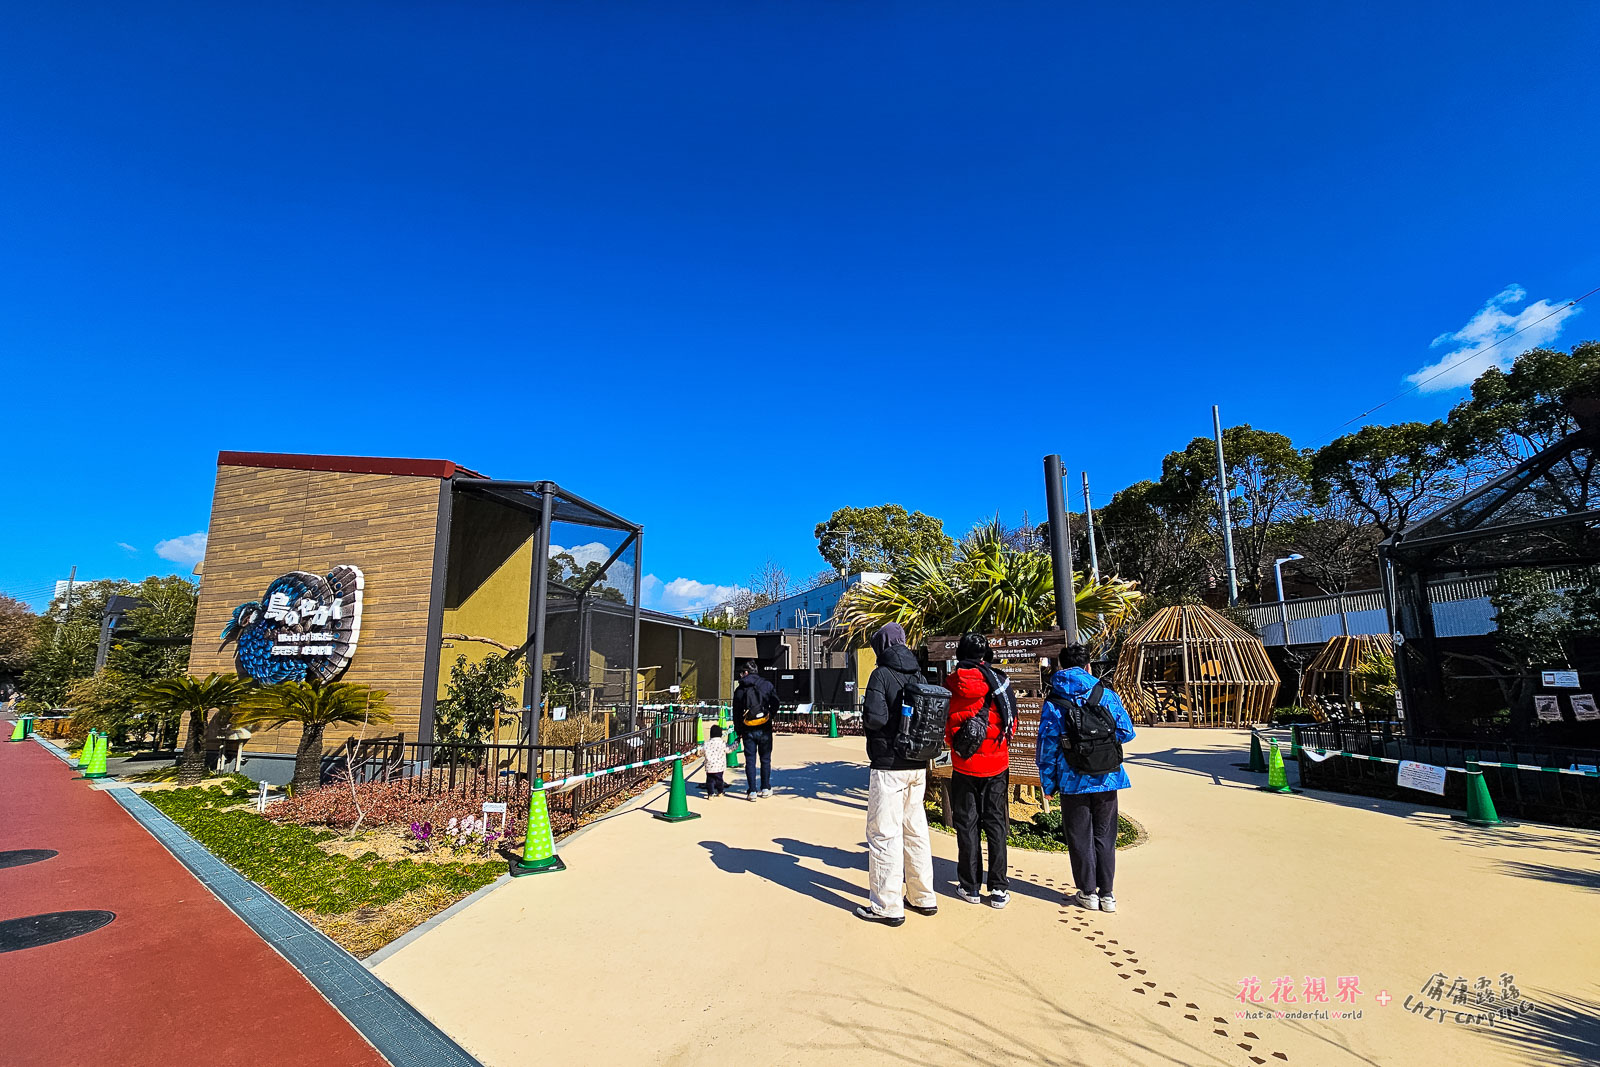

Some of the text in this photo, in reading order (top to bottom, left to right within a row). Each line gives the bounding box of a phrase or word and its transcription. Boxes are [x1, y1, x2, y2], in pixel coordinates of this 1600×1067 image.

[987, 637, 1044, 647] カイを作ったの?
